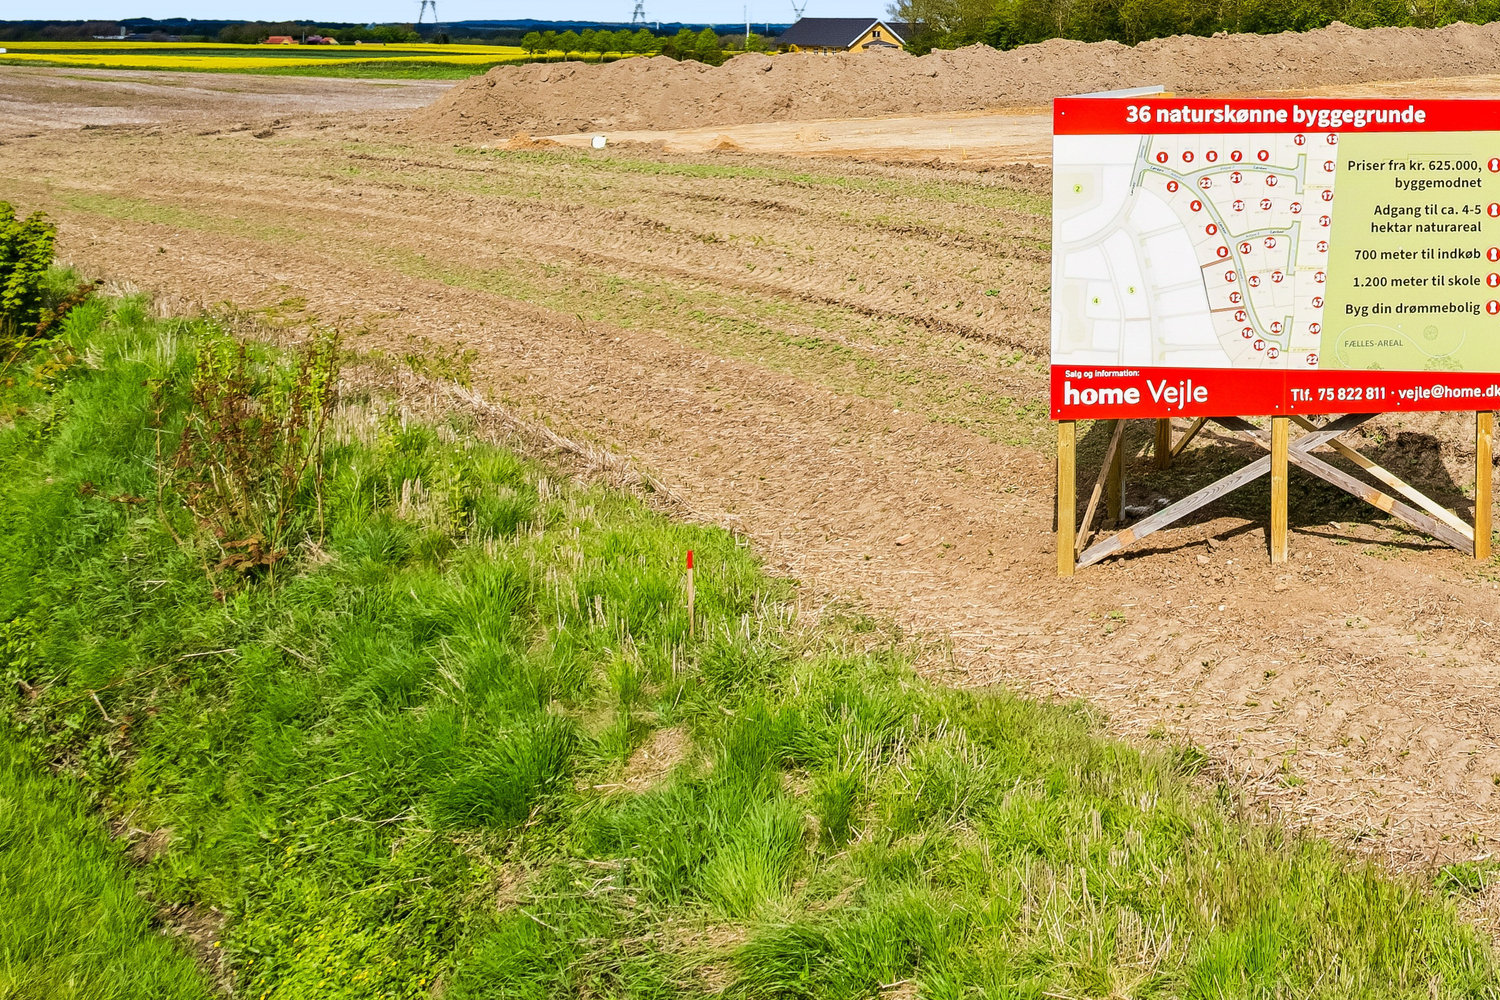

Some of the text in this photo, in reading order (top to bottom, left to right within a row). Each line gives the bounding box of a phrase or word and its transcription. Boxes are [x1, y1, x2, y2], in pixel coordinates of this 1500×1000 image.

[1126, 105, 1426, 127] 36 naturskønne byggegrunde
[1294, 135, 1305, 144] 11
[1327, 135, 1338, 144] 13
[1159, 153, 1166, 162] 1
[1184, 152, 1192, 161] 3
[1233, 152, 1240, 161] 7
[1259, 151, 1267, 160] 9
[1348, 160, 1481, 173] Priser fra kr. 625.000,
[1231, 173, 1242, 182] 21
[1266, 176, 1277, 185] 19
[1169, 182, 1176, 191] 2
[1201, 179, 1212, 188] 23
[1396, 177, 1481, 191] byggemodnet
[1322, 191, 1333, 200] 17
[1192, 201, 1200, 210] 4
[1260, 200, 1271, 209] 27
[1374, 204, 1421, 218] Adgang
[1425, 204, 1437, 215] til
[1462, 205, 1481, 214] 4-5
[1207, 225, 1215, 234] 6
[1371, 221, 1481, 232] hektar naturareal
[1219, 248, 1226, 257] 8
[1240, 244, 1251, 253] 41
[1355, 248, 1480, 260] 700 meter til indkøb
[1225, 272, 1236, 281] 10
[1272, 273, 1283, 282] 37
[1354, 275, 1480, 287] 1.200 meter til skole
[1230, 293, 1241, 302] 12
[1346, 302, 1480, 317] Byg din drømmebolig
[1235, 312, 1246, 321] 14
[1242, 328, 1253, 337] 16
[1268, 349, 1279, 358] 20
[1307, 355, 1318, 364] 22
[1065, 369, 1139, 379] Salg og information:
[1064, 379, 1208, 410] home Vejle
[1291, 389, 1313, 401] Tlf.
[1318, 388, 1334, 401] 75
[1338, 387, 1362, 400] 822
[1366, 387, 1385, 400] 811
